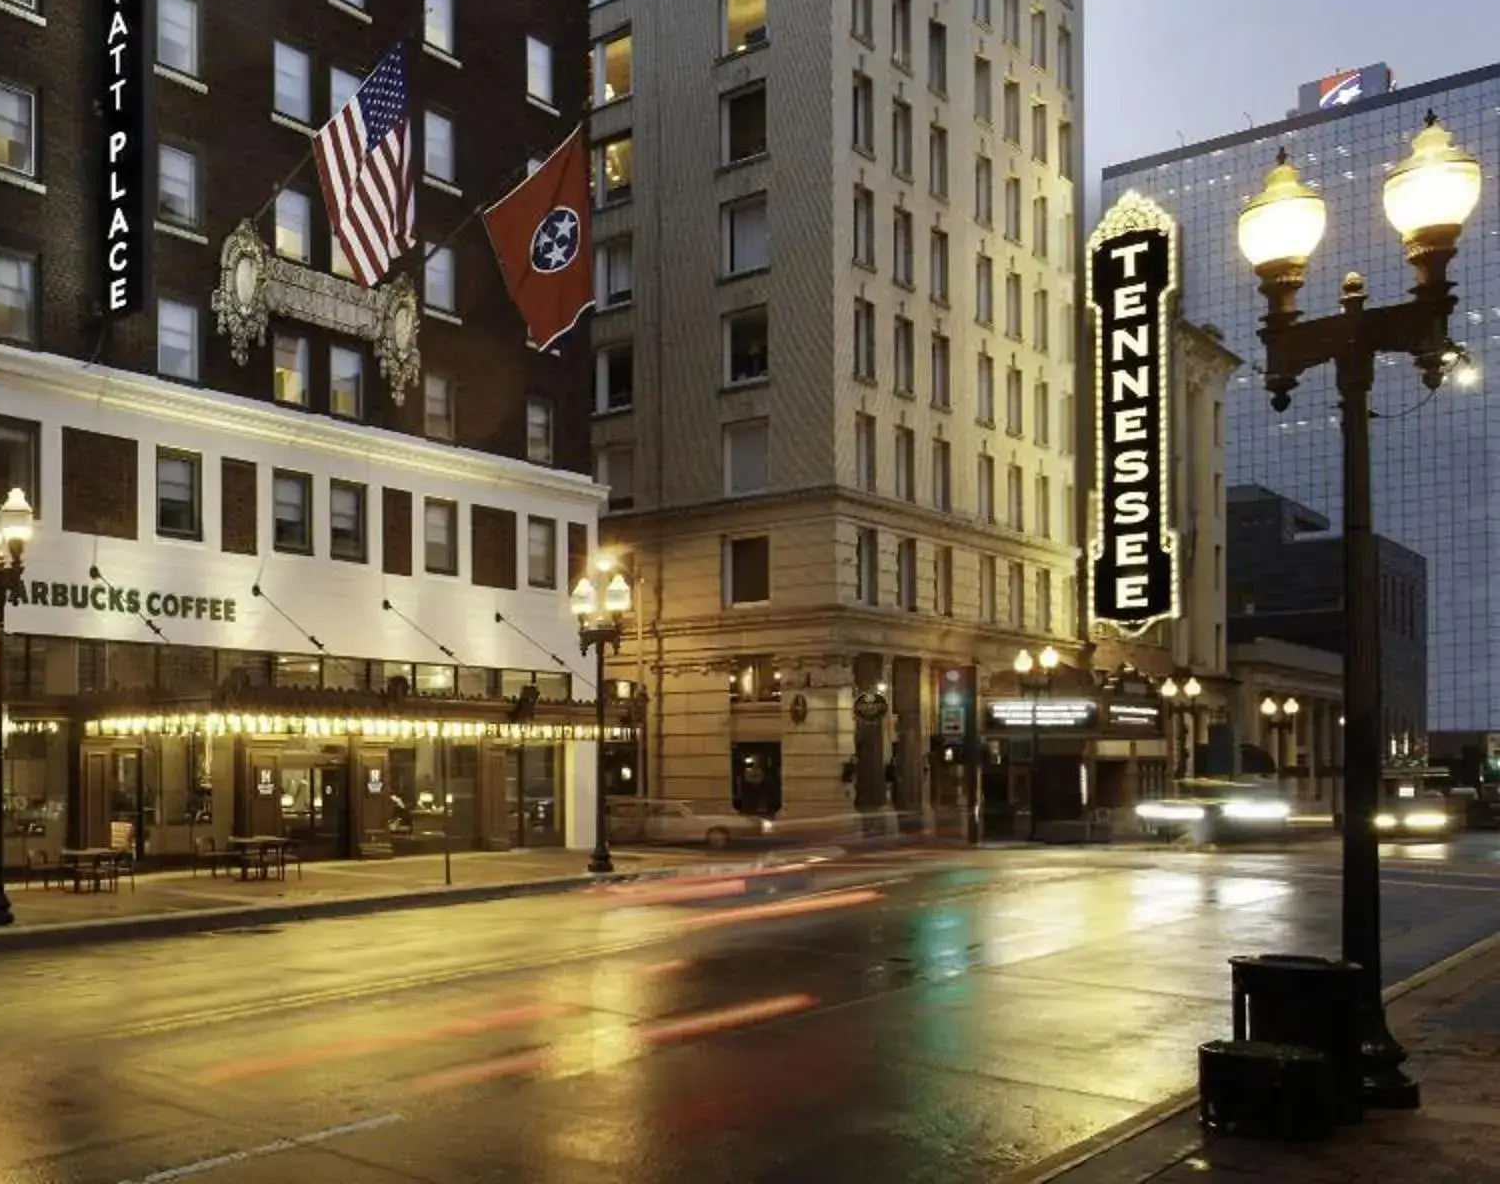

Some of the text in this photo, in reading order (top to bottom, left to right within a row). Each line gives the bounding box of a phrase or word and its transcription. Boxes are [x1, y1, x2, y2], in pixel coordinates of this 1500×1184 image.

[107, 131, 129, 310] PLACE
[1111, 242, 1150, 610] TENNESSEE
[145, 592, 237, 622] COFFEE
